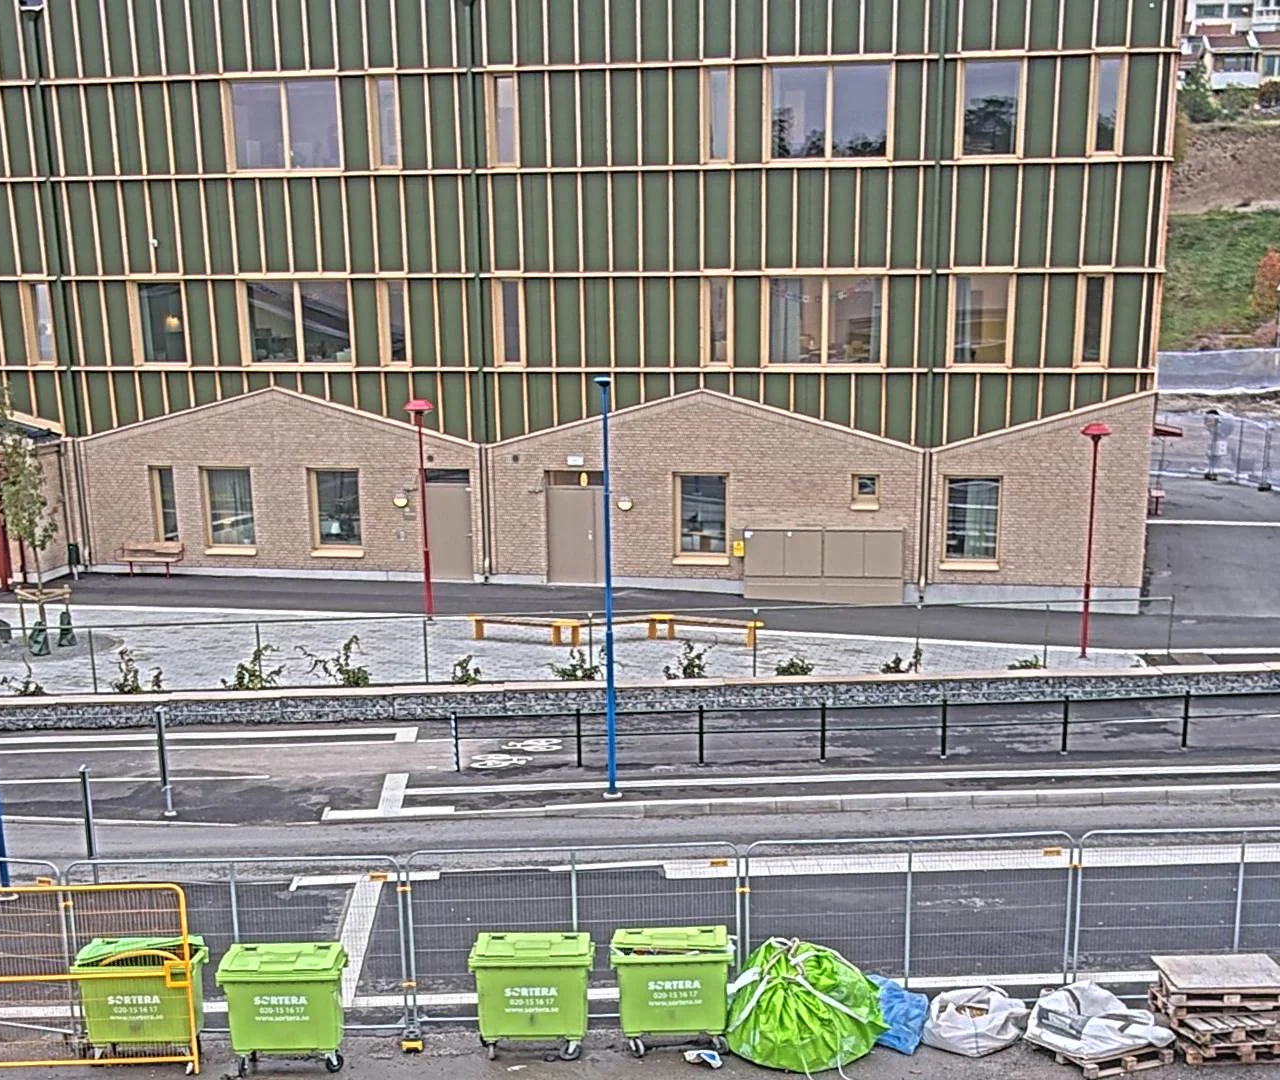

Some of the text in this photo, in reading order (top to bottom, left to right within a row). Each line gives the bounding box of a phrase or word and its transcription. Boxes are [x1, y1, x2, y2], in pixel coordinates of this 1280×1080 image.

[648, 980, 701, 990] SORTERA
[504, 987, 558, 997] SORTERA
[107, 995, 160, 1004] SORTERA
[253, 996, 308, 1005] SORTERA
